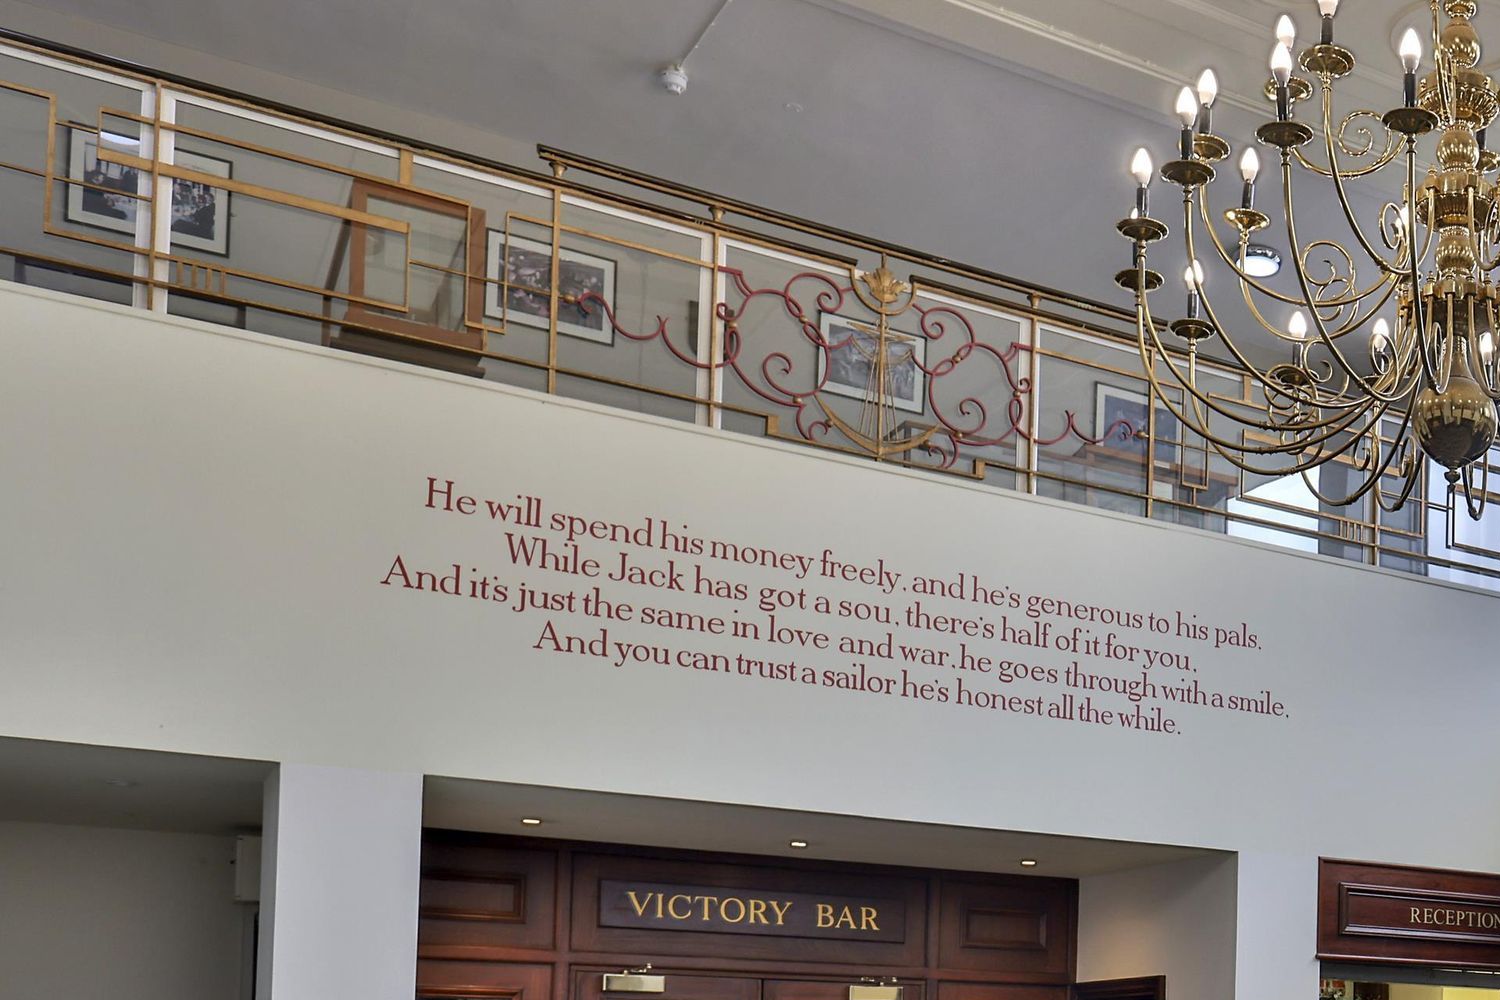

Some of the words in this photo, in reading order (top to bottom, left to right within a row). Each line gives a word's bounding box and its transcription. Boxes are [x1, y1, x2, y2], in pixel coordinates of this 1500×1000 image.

[424, 476, 477, 516] He
[484, 494, 543, 529] will
[549, 515, 654, 548] spend
[659, 519, 704, 556] his
[709, 540, 815, 580] money
[911, 572, 966, 601] and
[971, 575, 1021, 609] he's
[1025, 595, 1143, 629] generous
[1147, 612, 1170, 634] to
[1175, 610, 1209, 641] his
[503, 531, 601, 578] While
[607, 551, 685, 592] Jack
[693, 564, 748, 601] has
[758, 588, 807, 613] got
[814, 596, 832, 615] a
[838, 600, 900, 627] sou,
[905, 600, 995, 640] there's
[1000, 615, 1052, 649] half
[1055, 627, 1083, 654] of
[1084, 629, 1101, 657] it
[1104, 632, 1140, 662] for
[379, 554, 463, 596] And
[469, 567, 509, 603] it's
[511, 582, 577, 614] just
[581, 586, 634, 622] the
[640, 607, 725, 635] same
[731, 609, 760, 641] in
[767, 614, 830, 650] love
[838, 632, 894, 660] and
[958, 642, 992, 673] he
[998, 660, 1058, 684] goes
[1064, 660, 1158, 703] through
[1160, 677, 1208, 706] with
[1210, 692, 1225, 709] a
[532, 619, 609, 658] And
[613, 641, 671, 668] you
[676, 650, 731, 673] can
[735, 653, 798, 682] trust
[801, 667, 817, 685] a
[822, 662, 897, 695] sailor
[900, 668, 949, 703] he's
[955, 677, 1044, 717] honest
[1047, 693, 1075, 721] all
[1077, 696, 1114, 726] the
[1116, 703, 1182, 736] while.
[627, 890, 793, 925] VICTORY
[815, 903, 881, 931] BAR
